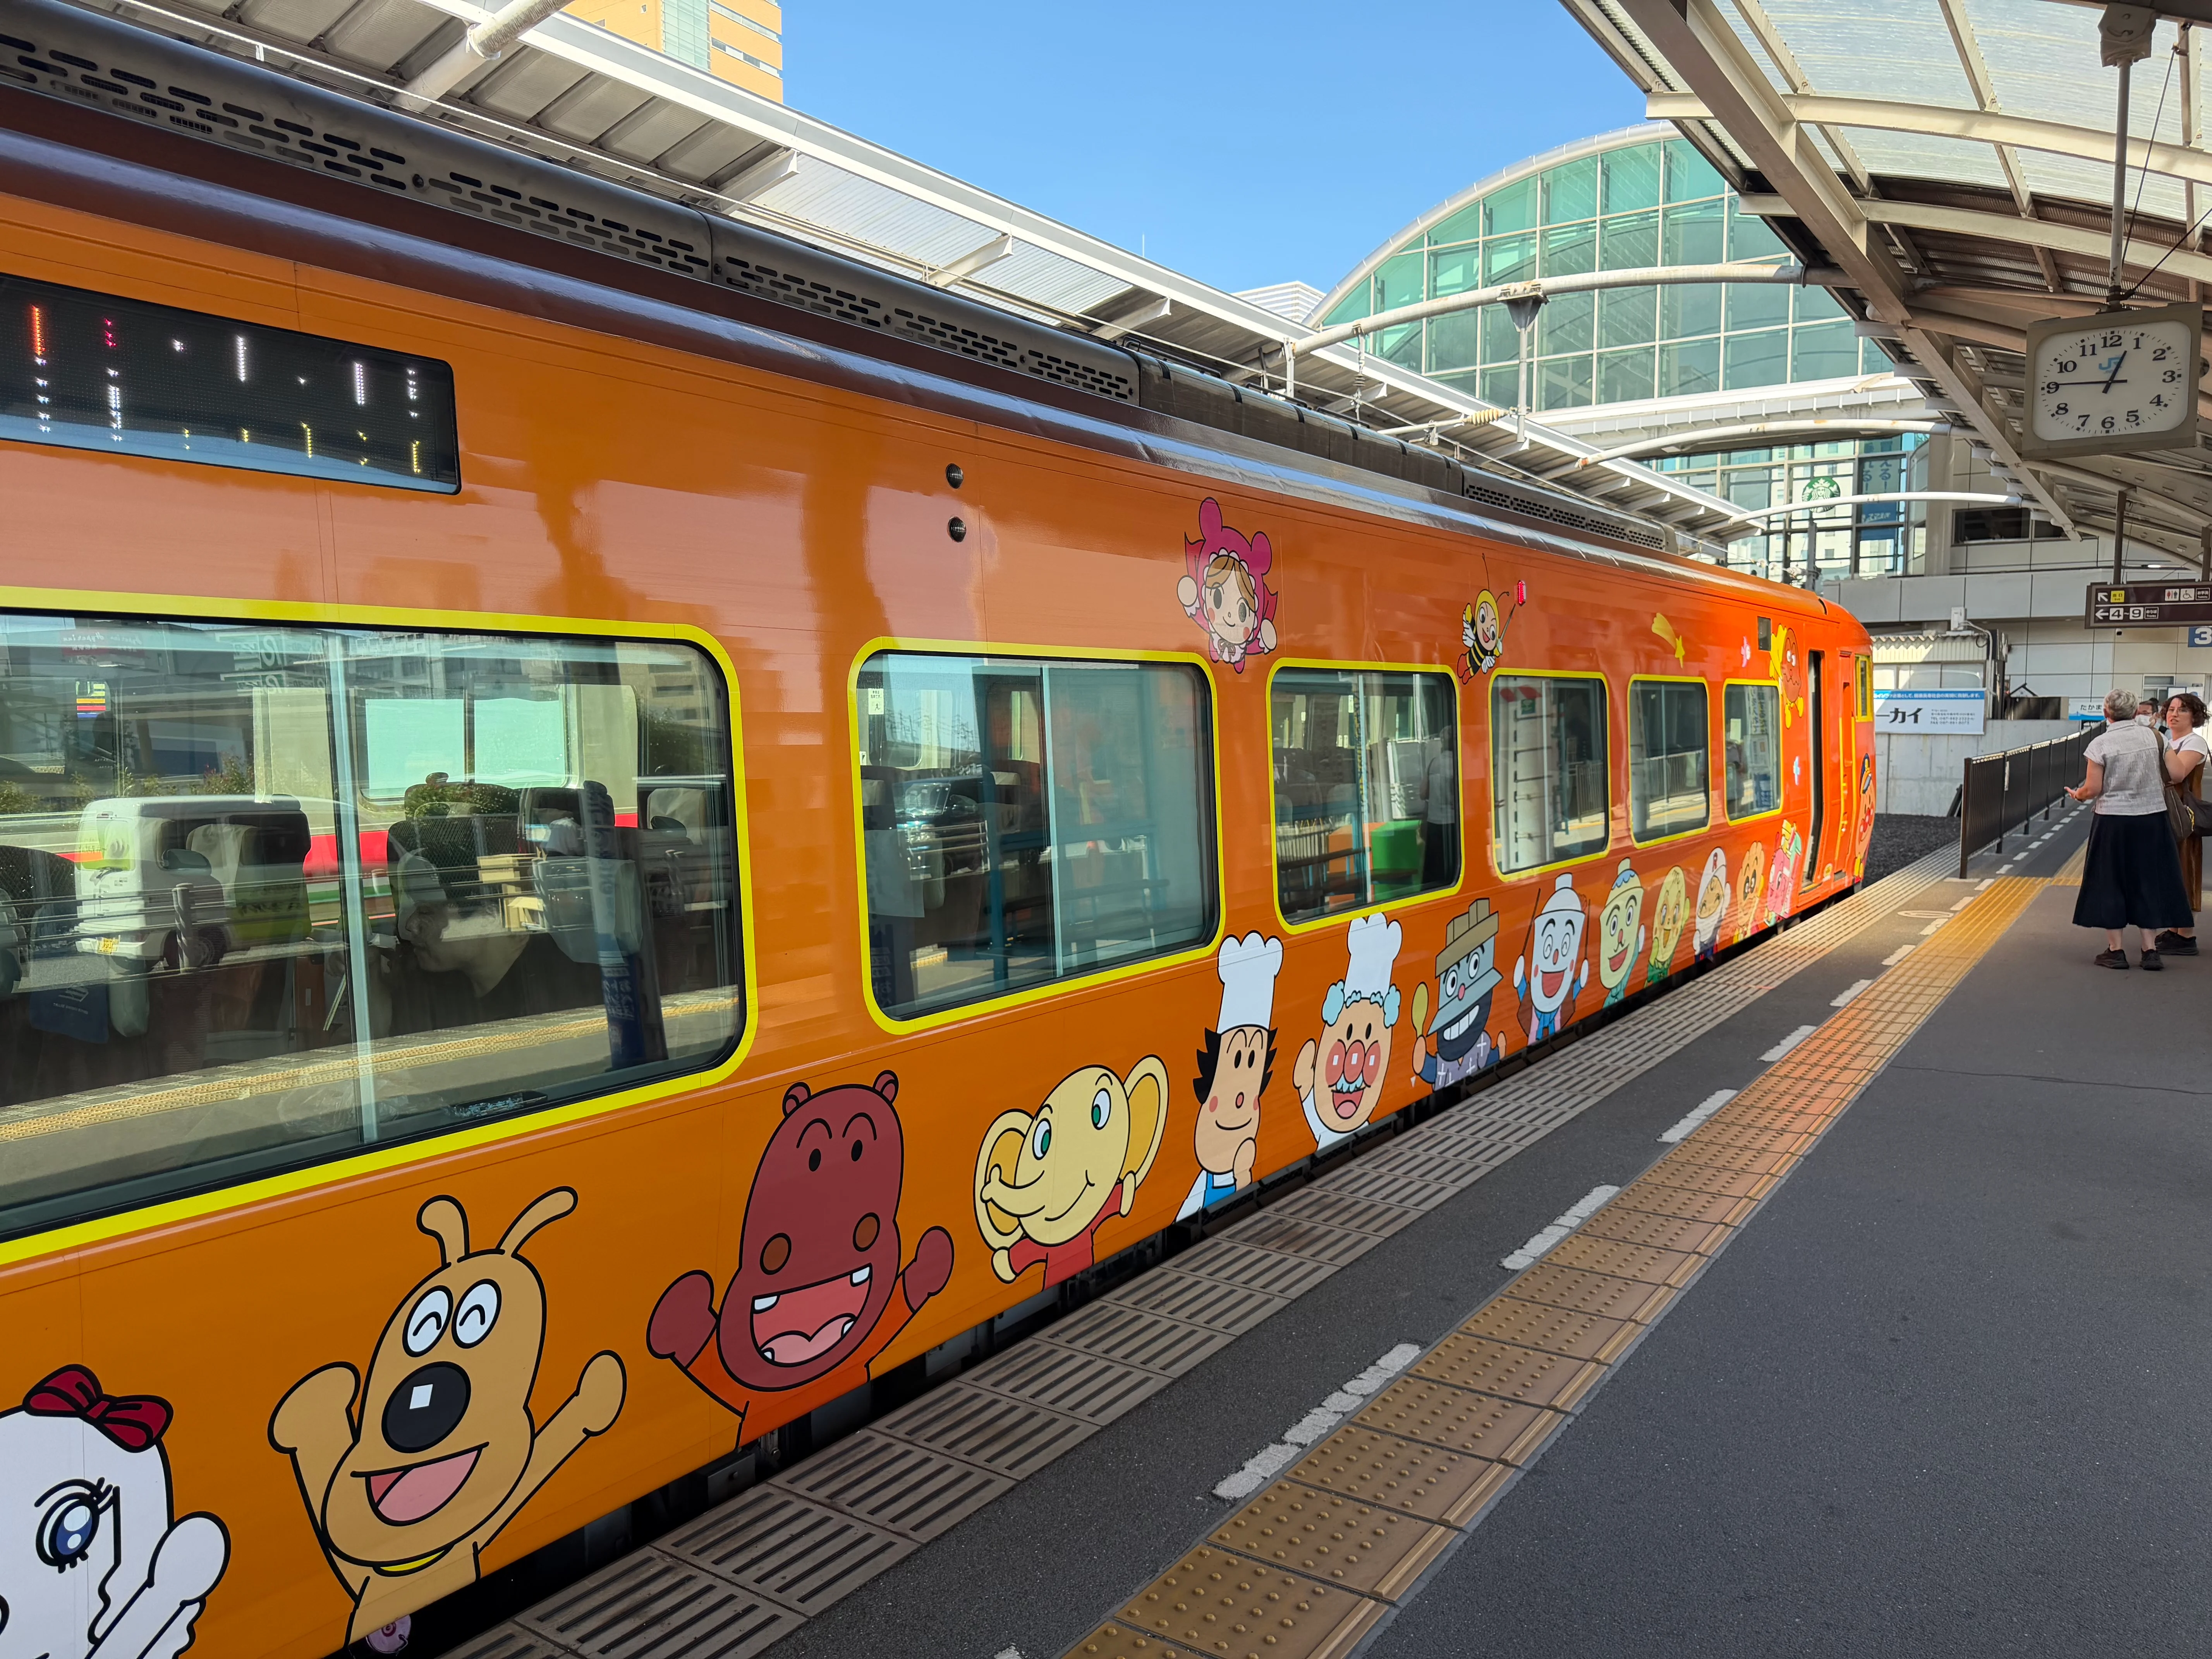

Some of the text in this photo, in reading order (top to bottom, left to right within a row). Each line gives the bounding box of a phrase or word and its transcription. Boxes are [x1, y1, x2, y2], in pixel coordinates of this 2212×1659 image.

[2101, 335, 2122, 348] 12
[2133, 337, 2141, 349] 1
[2079, 344, 2097, 357] 11
[2152, 349, 2166, 361] 2
[2057, 361, 2077, 373] 10
[2162, 371, 2176, 383] 3
[2046, 381, 2060, 394] 9
[2149, 394, 2164, 406] 4
[2055, 403, 2068, 415] 8
[2078, 414, 2090, 427] 7
[2126, 410, 2139, 422] 5
[2101, 417, 2114, 429] 6
[2111, 610, 2121, 618] 4
[2132, 609, 2141, 618] 9
[2194, 627, 2212, 644] 3
